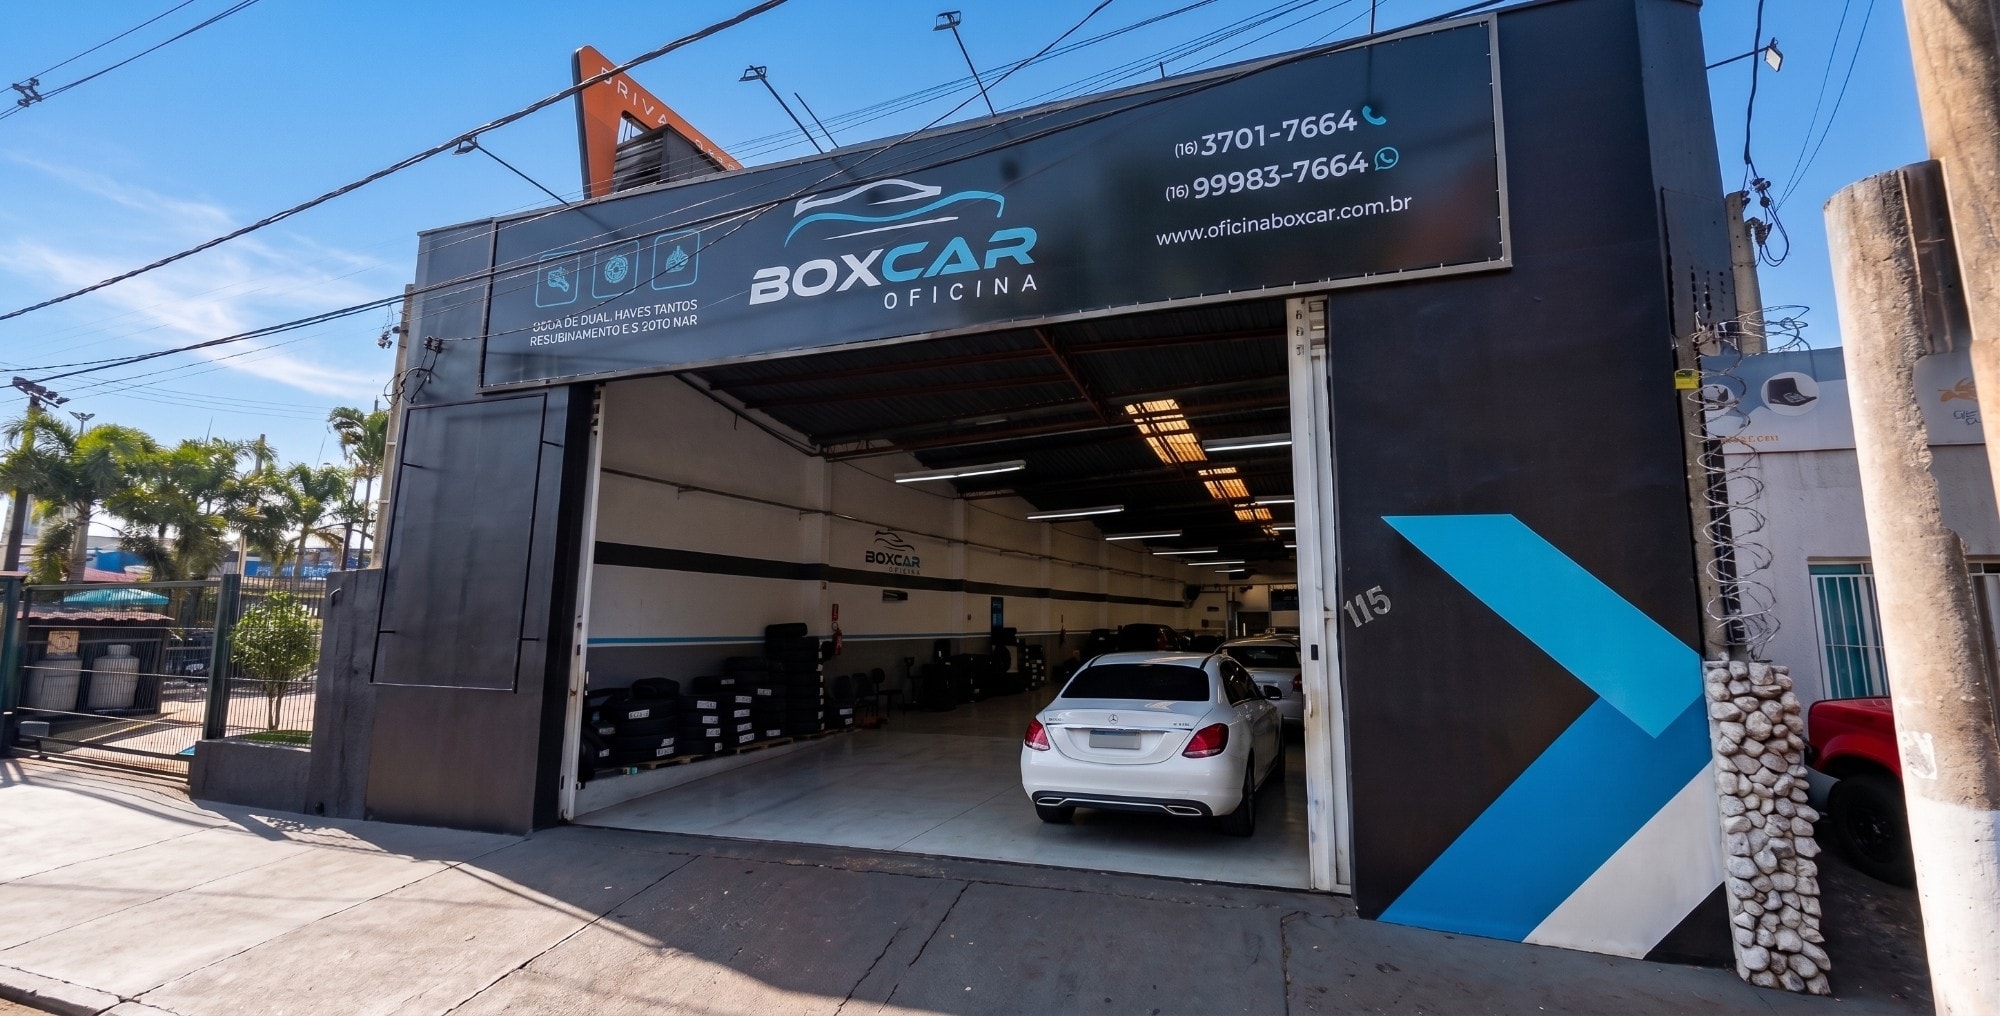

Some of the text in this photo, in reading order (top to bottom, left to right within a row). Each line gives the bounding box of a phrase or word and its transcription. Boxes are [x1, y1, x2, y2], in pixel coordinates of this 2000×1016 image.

[1174, 109, 1357, 158] (16) 3701-7664
[1165, 151, 1368, 201] (16) 99983-7664
[1156, 195, 1412, 246] www.oficinaboxcar.com.br
[749, 227, 1037, 305] BOXCAR
[615, 305, 651, 320] HAVES
[653, 299, 698, 315] TANTOS
[884, 274, 1037, 310] OFICINA
[530, 325, 620, 346] RESUBINAMENTO
[673, 314, 698, 328] NAR
[865, 550, 920, 568] BOXCAR
[1343, 585, 1391, 628] 115
